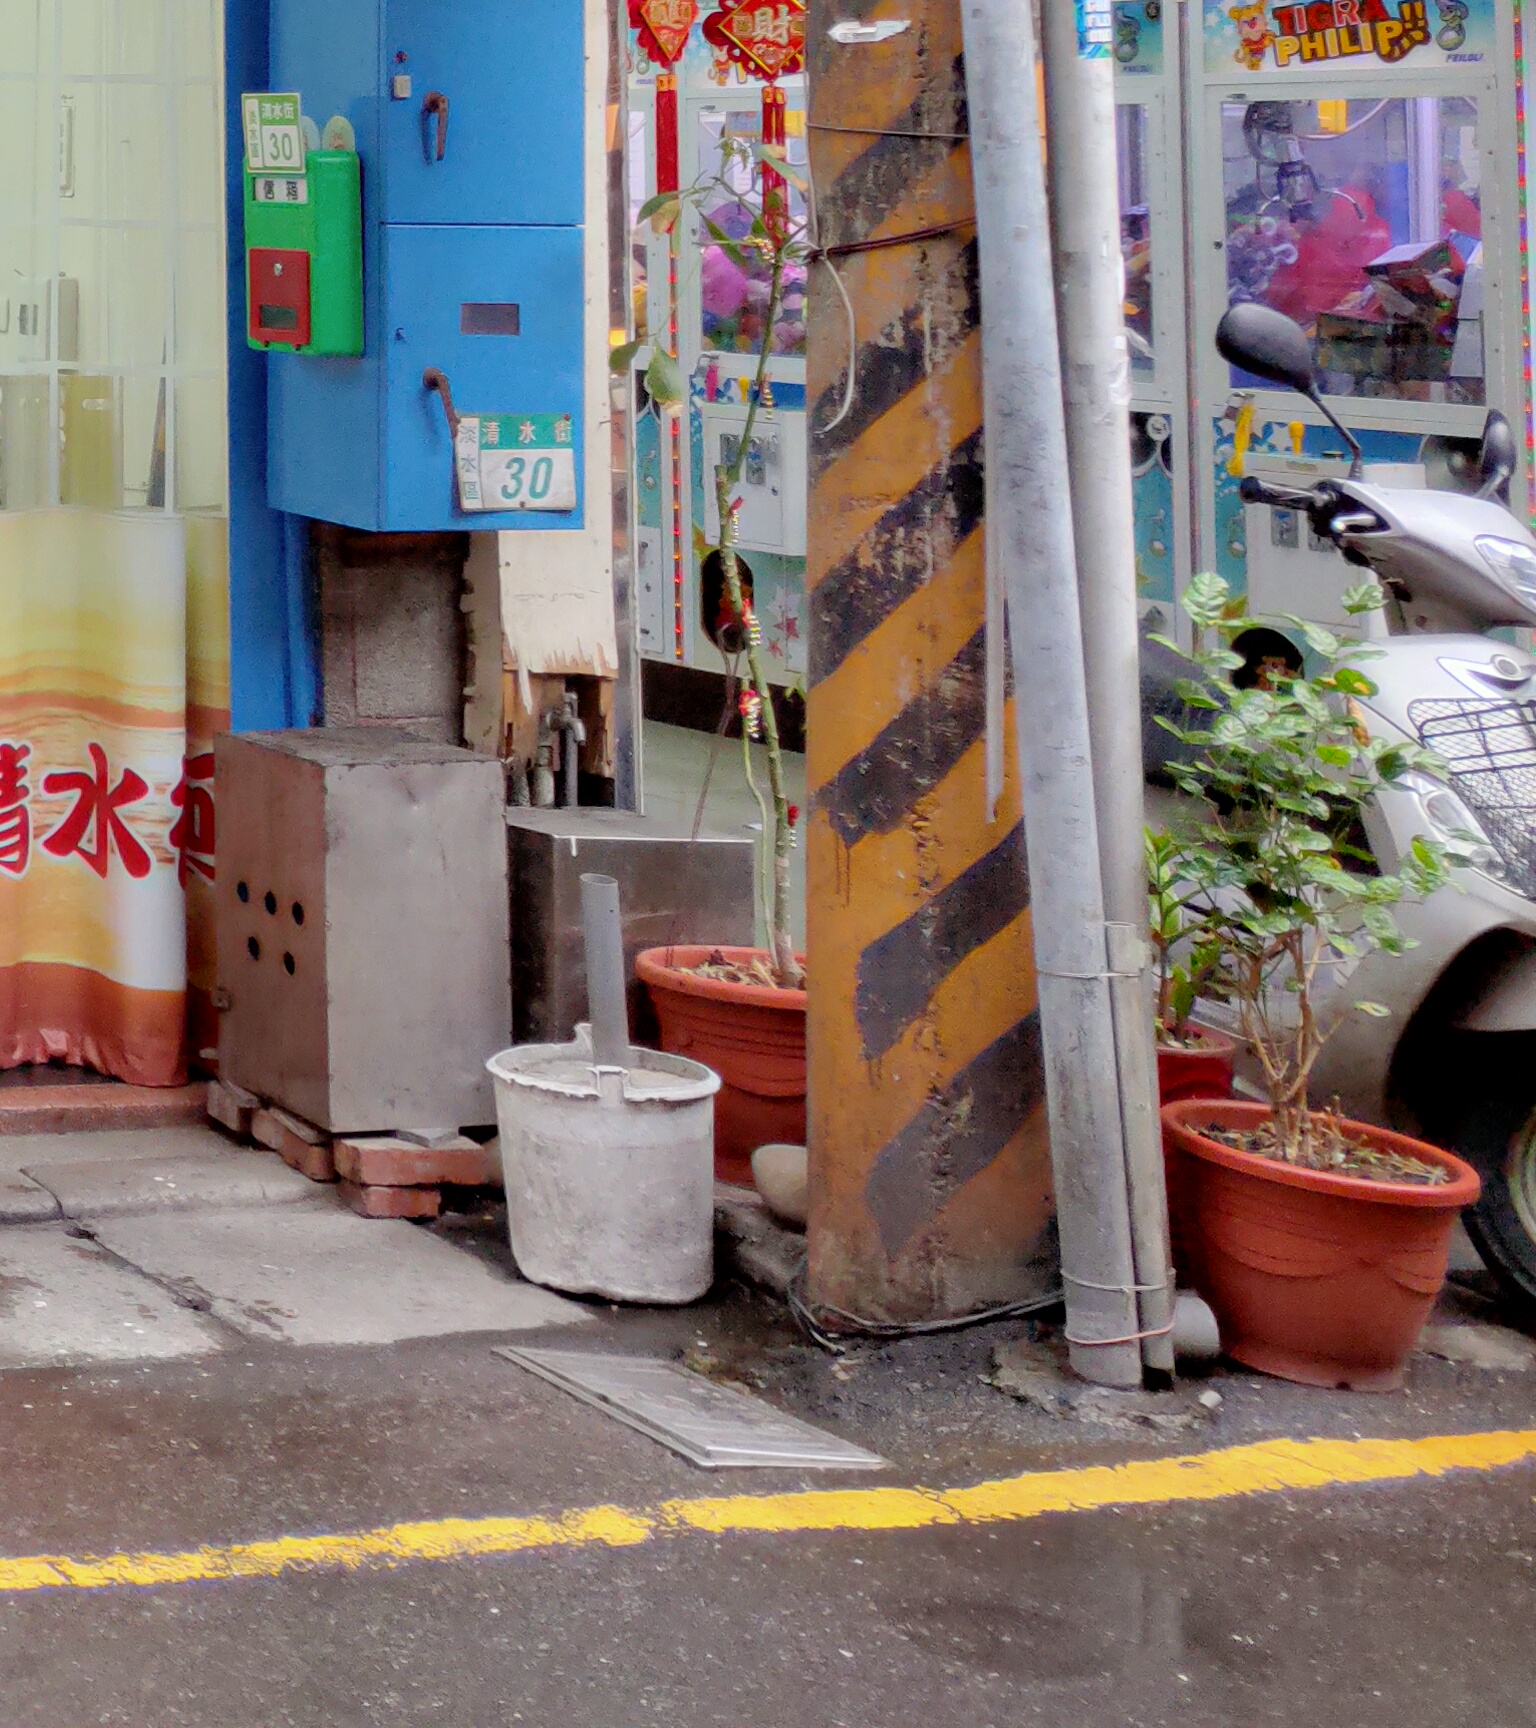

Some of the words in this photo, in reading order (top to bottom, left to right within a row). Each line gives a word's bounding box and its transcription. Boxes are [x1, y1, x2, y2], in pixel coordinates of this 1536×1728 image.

[269, 132, 293, 161] 30
[481, 419, 572, 444] 清水街
[500, 456, 553, 500] 30
